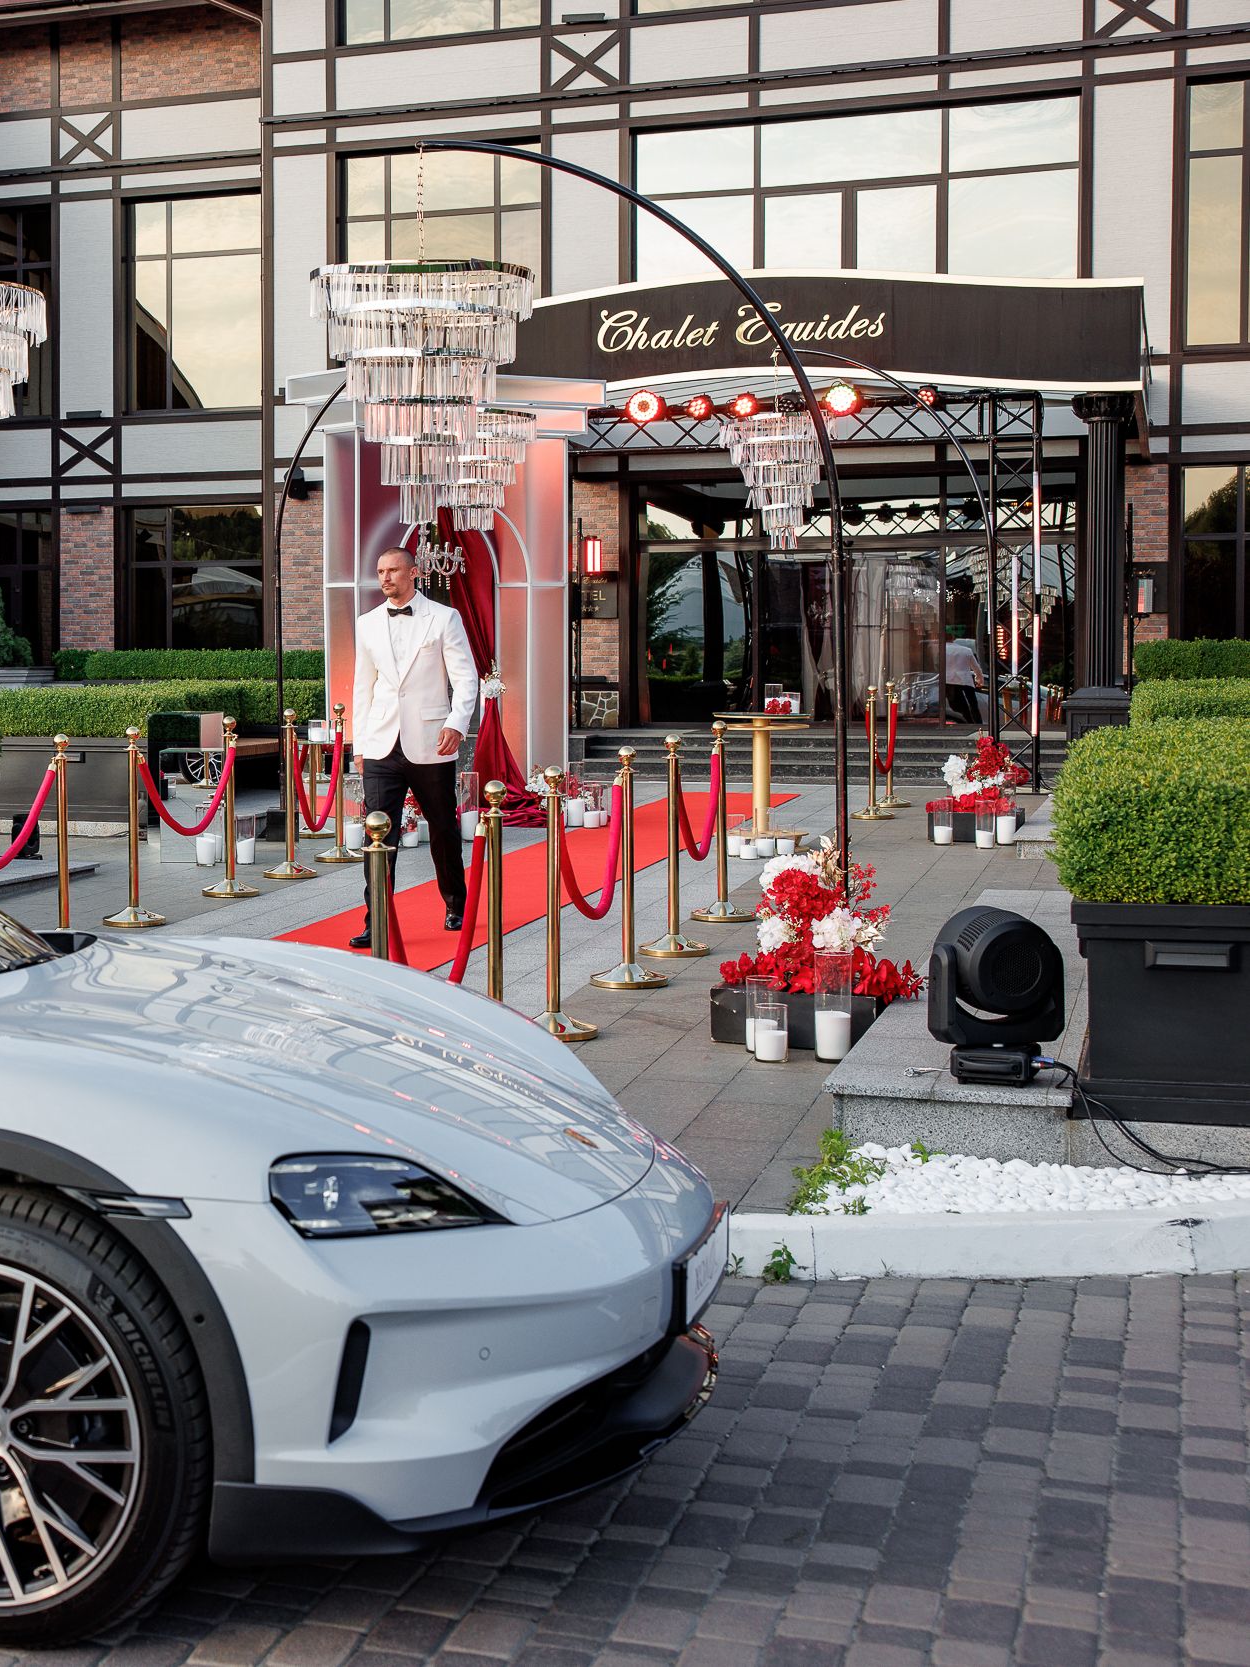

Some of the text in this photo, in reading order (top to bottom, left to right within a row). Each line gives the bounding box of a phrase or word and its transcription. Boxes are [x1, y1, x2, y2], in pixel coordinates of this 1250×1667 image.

[597, 309, 719, 352] Chalet
[581, 589, 606, 601] TEL
[112, 1311, 172, 1427] MICHELIN
